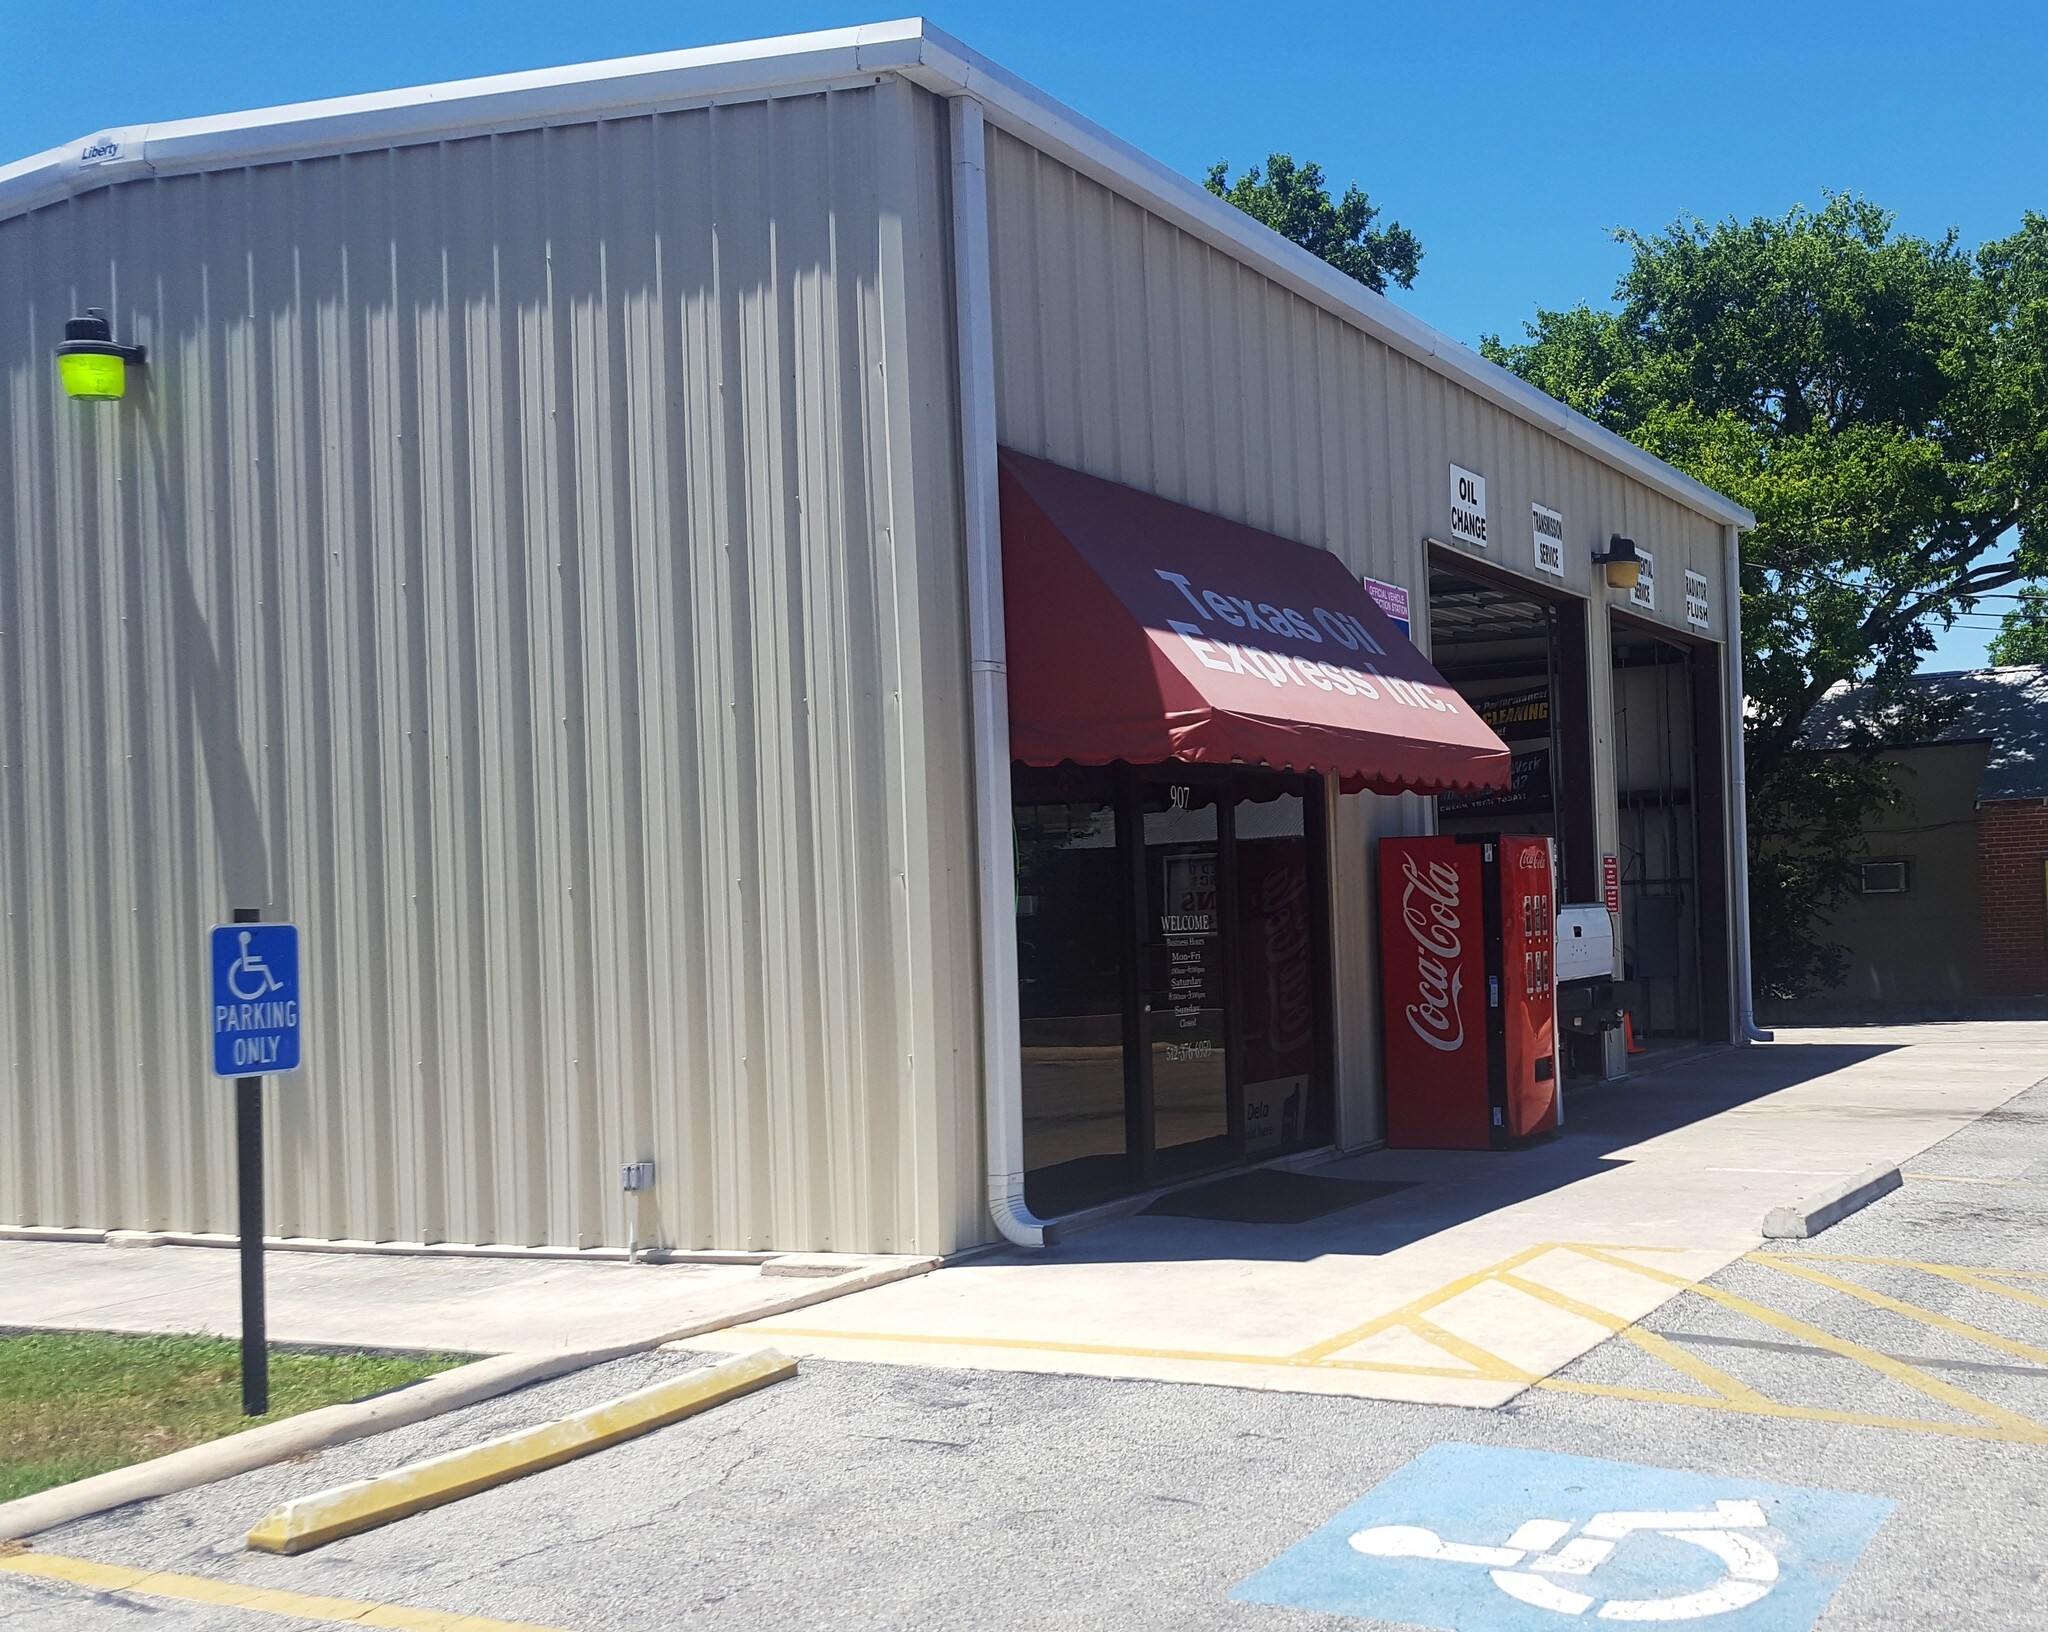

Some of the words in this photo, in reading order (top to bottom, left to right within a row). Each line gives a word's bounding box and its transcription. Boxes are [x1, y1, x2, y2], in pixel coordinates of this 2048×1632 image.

[82, 143, 120, 161] Liberty
[1459, 477, 1478, 506] OIL
[1451, 506, 1487, 541] CHANGE
[1532, 510, 1563, 540] TRANSMISSION
[1539, 542, 1559, 569] SERVICE
[1153, 568, 1323, 644] Texas
[1312, 606, 1387, 657] Oil
[1687, 600, 1709, 622] FLUSH
[1166, 619, 1380, 702] Express
[1363, 662, 1460, 714] Inc.
[1482, 702, 1549, 726] CLEANING
[1170, 785, 1190, 809] 907
[1160, 914, 1210, 932] WELCOME
[1189, 937, 1205, 946] Hours
[1402, 850, 1464, 1051] Coca-Cola
[1171, 951, 1201, 962] Mon-Fri
[1170, 976, 1203, 987] Saturday
[215, 1000, 297, 1033] PARKING
[1174, 1003, 1201, 1015] Sunday
[234, 1035, 281, 1066] ONLY
[1247, 1100, 1269, 1121] Delo
